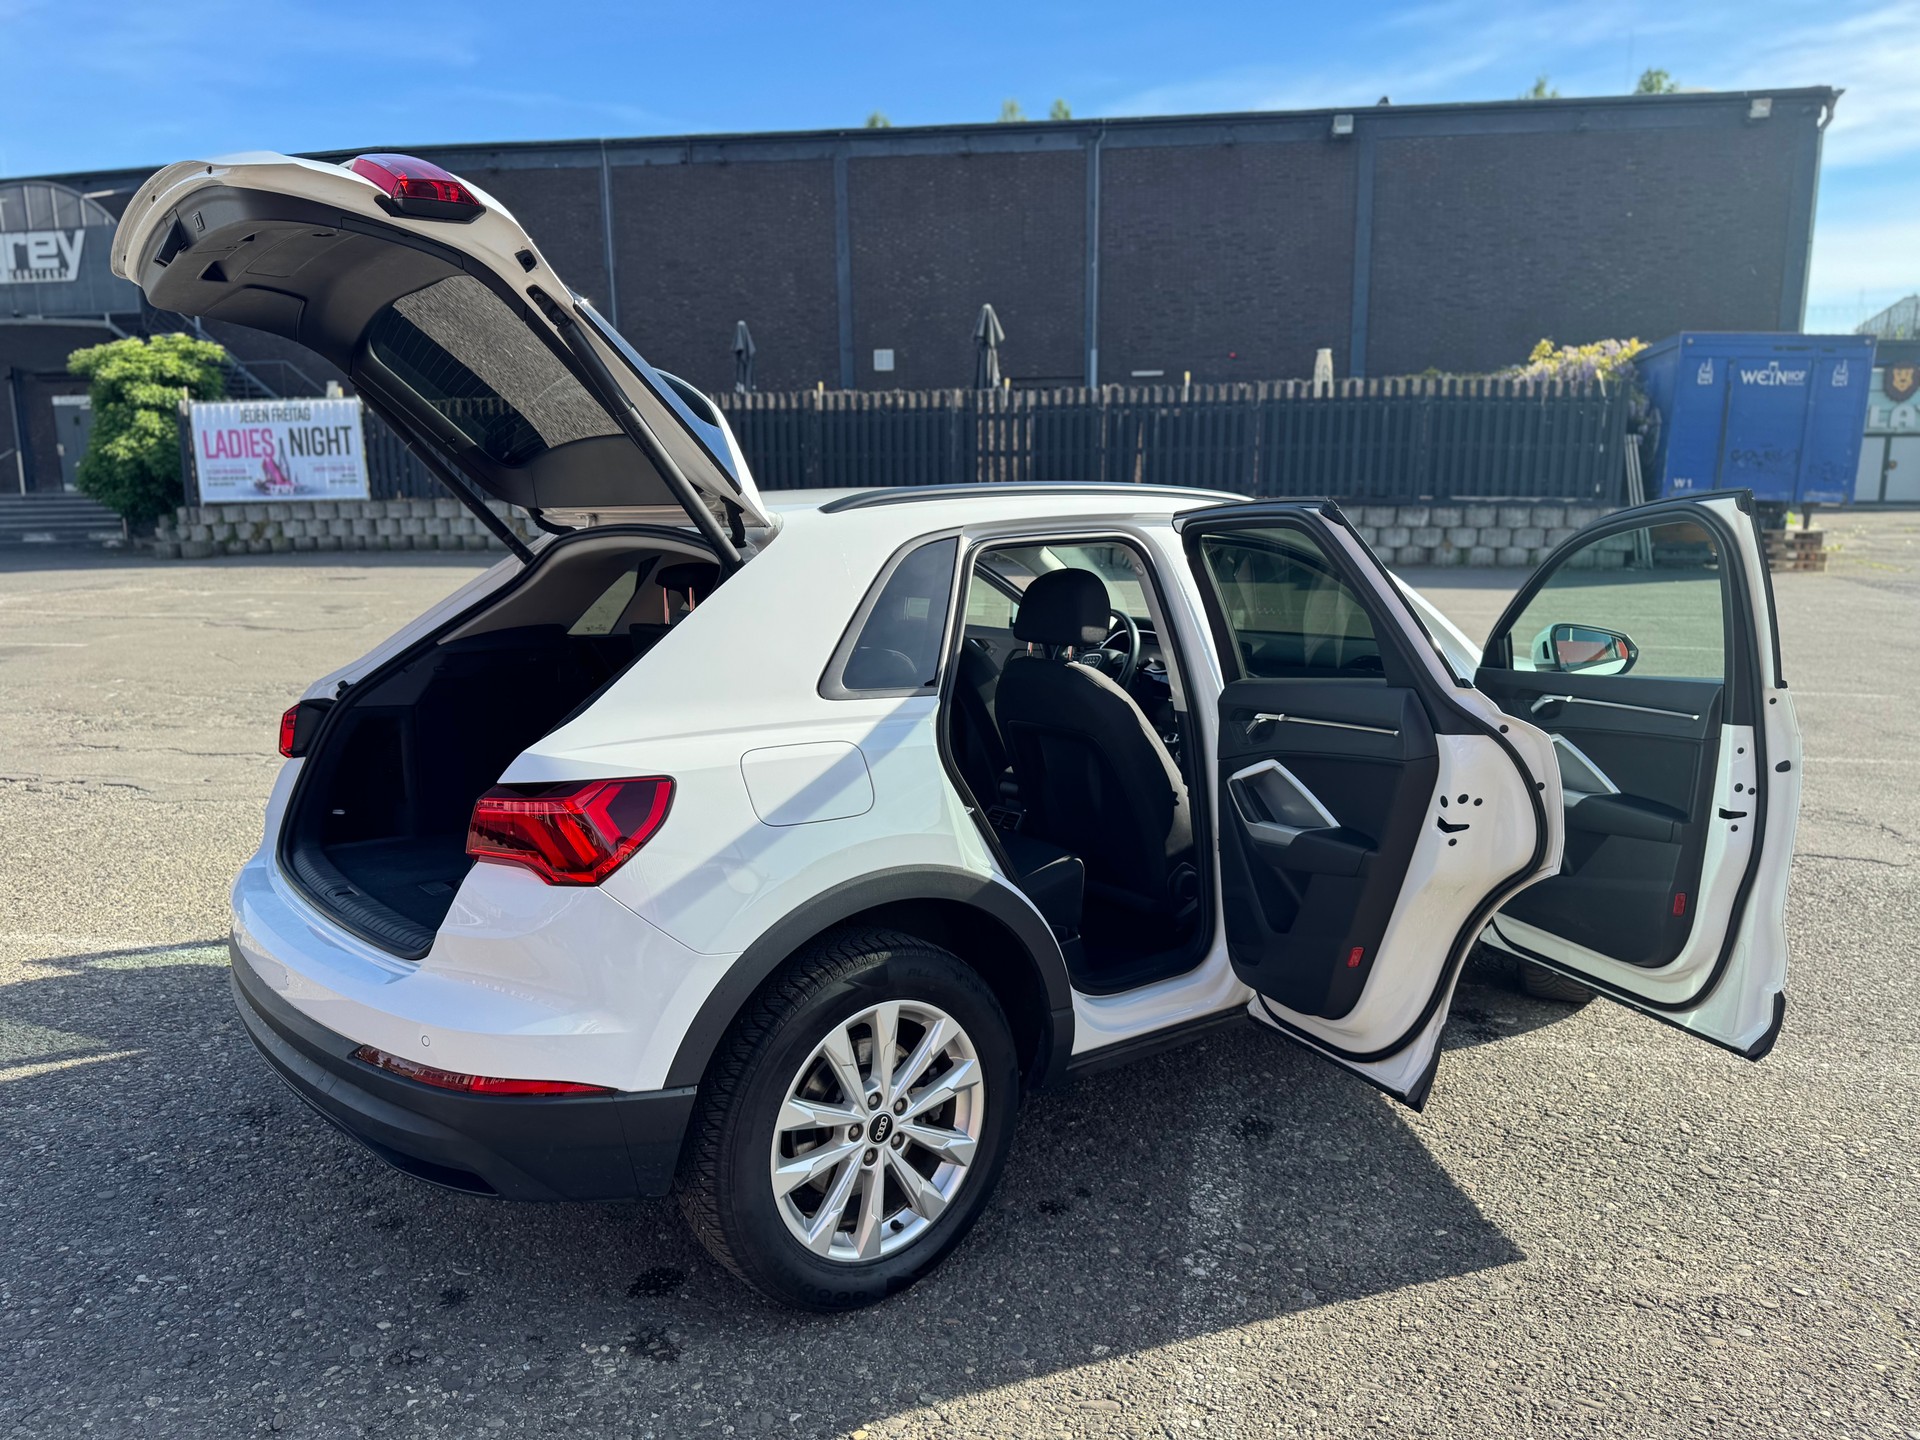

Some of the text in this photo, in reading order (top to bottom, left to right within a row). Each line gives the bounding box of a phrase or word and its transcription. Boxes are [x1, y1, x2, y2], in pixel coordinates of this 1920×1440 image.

[0, 230, 85, 283] rey
[240, 406, 311, 423] JEDEN FREITAG
[202, 426, 352, 459] LADIES NIGHT
